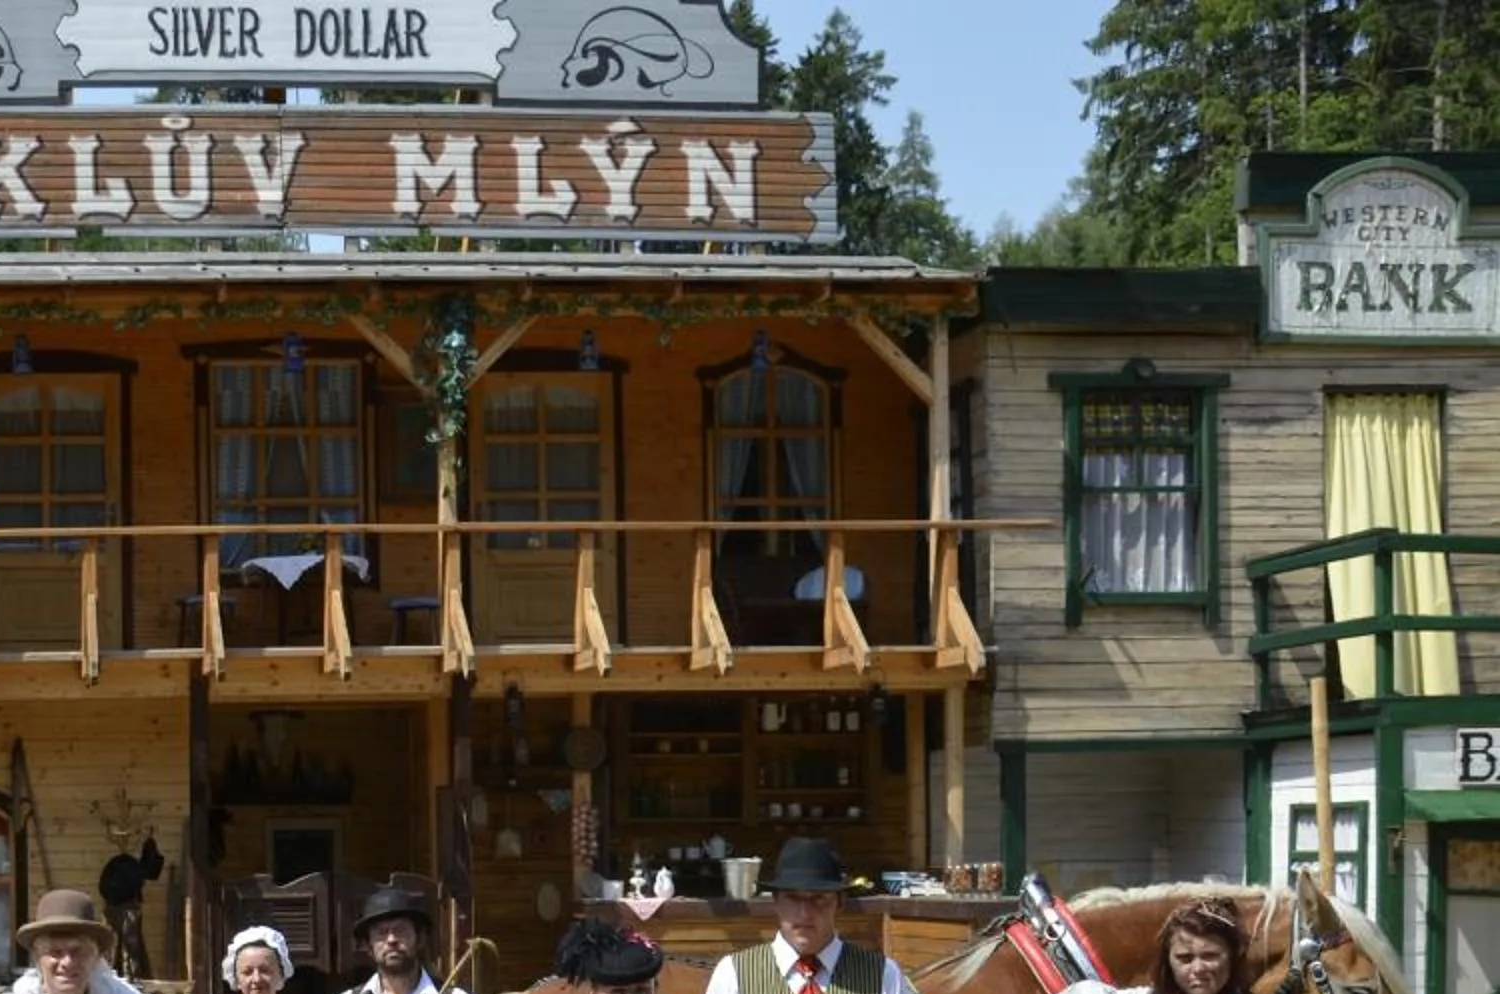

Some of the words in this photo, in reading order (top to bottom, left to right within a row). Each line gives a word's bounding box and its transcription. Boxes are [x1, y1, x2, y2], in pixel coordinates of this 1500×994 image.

[147, 7, 263, 58] SILVER
[294, 8, 430, 59] DOLLAR
[389, 116, 763, 227] MLÝN
[1320, 205, 1449, 232] WESTERN
[1357, 225, 1412, 242] CITY
[1295, 260, 1476, 313] BANK
[1459, 732, 1500, 783] B
